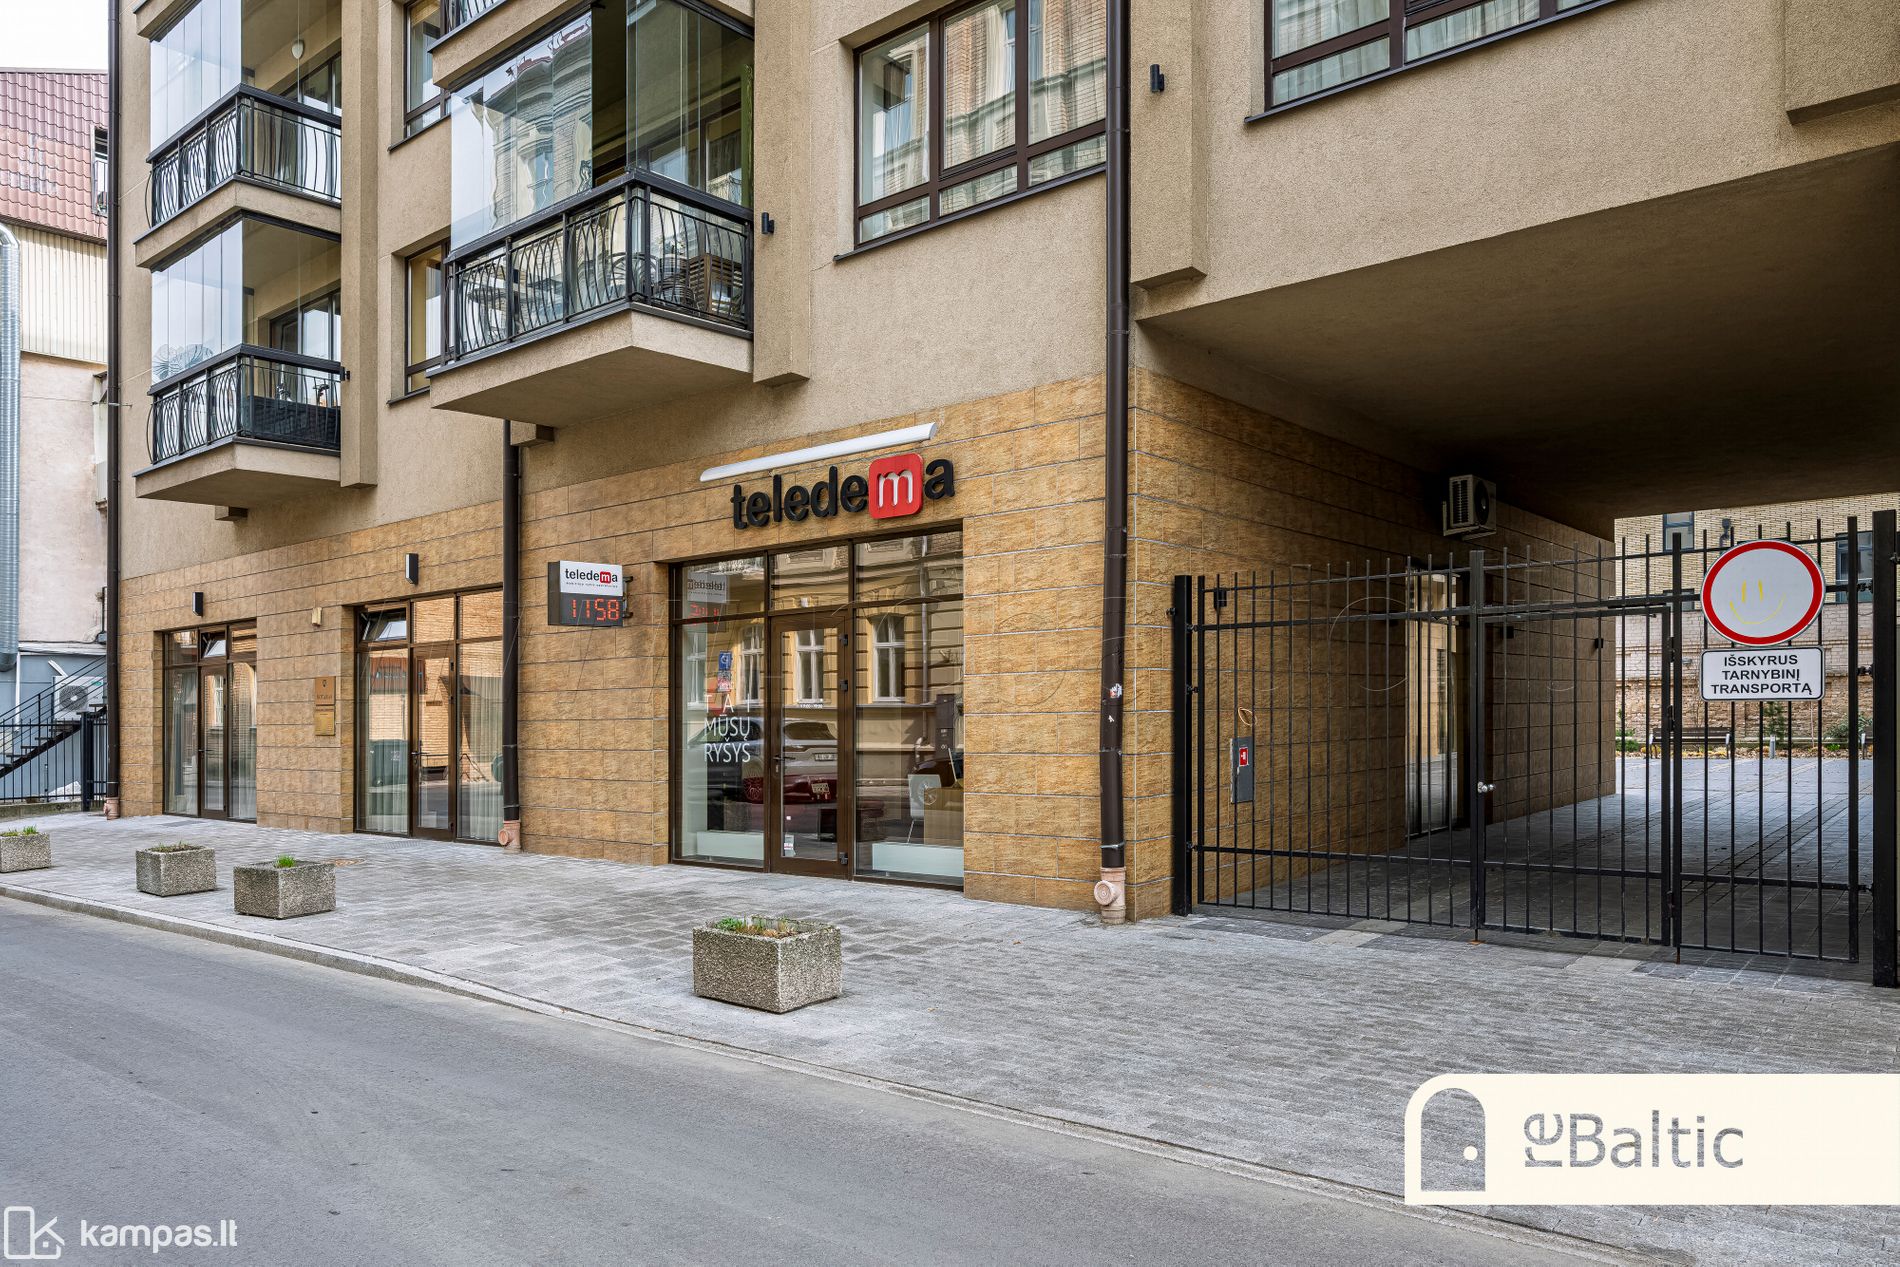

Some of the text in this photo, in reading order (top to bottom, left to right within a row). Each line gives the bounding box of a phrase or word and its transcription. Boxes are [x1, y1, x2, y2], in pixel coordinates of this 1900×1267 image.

[730, 453, 955, 529] teledema
[564, 568, 618, 584] teledema
[1724, 654, 1798, 666] IŠSKYRUS
[1722, 668, 1800, 681] TARNYBINĮ
[1711, 683, 1812, 695] TRANSPORTĄ
[704, 714, 750, 741] MŪSŲ
[704, 737, 751, 763] RYŠYS
